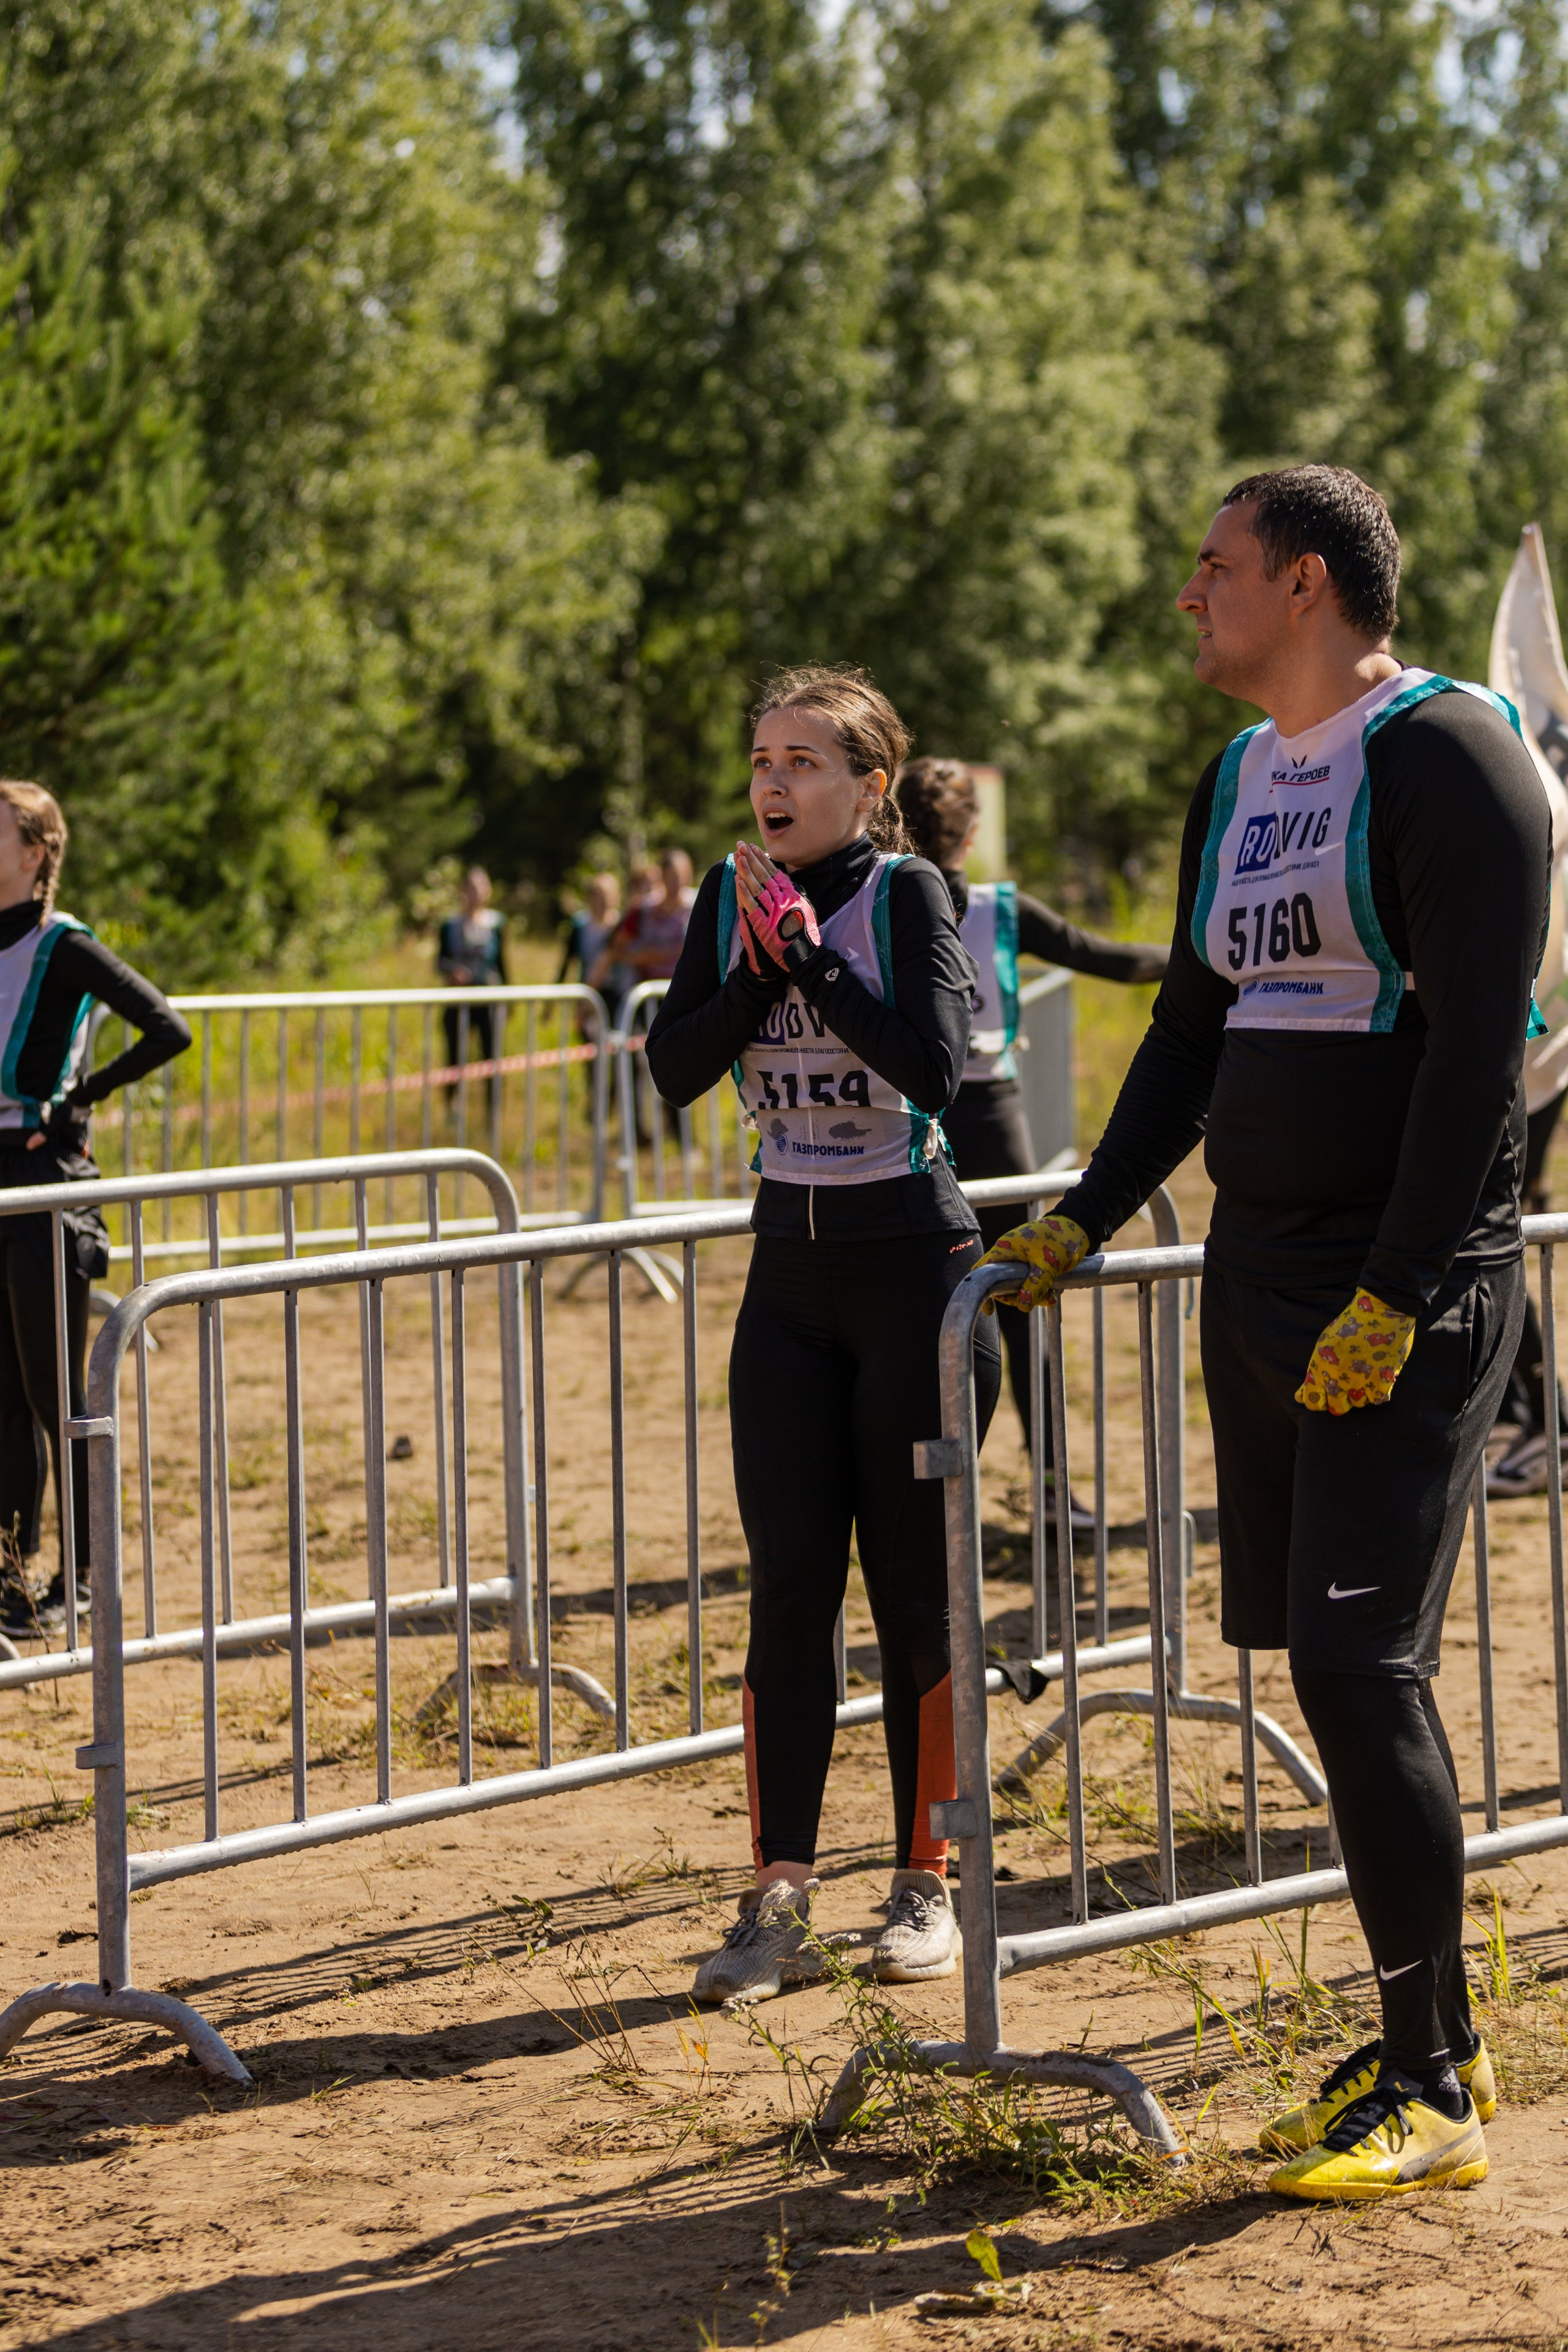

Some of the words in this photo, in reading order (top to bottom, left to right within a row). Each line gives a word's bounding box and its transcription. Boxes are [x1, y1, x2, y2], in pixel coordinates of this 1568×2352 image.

[1289, 765, 1330, 782] ГЕРОЕВ
[1228, 892, 1321, 971] 5160
[1259, 982, 1324, 994] ГАЗПРОМБАНК
[756, 1070, 871, 1109] 5159
[792, 1142, 864, 1156] ГАЗПРОМБАНК
